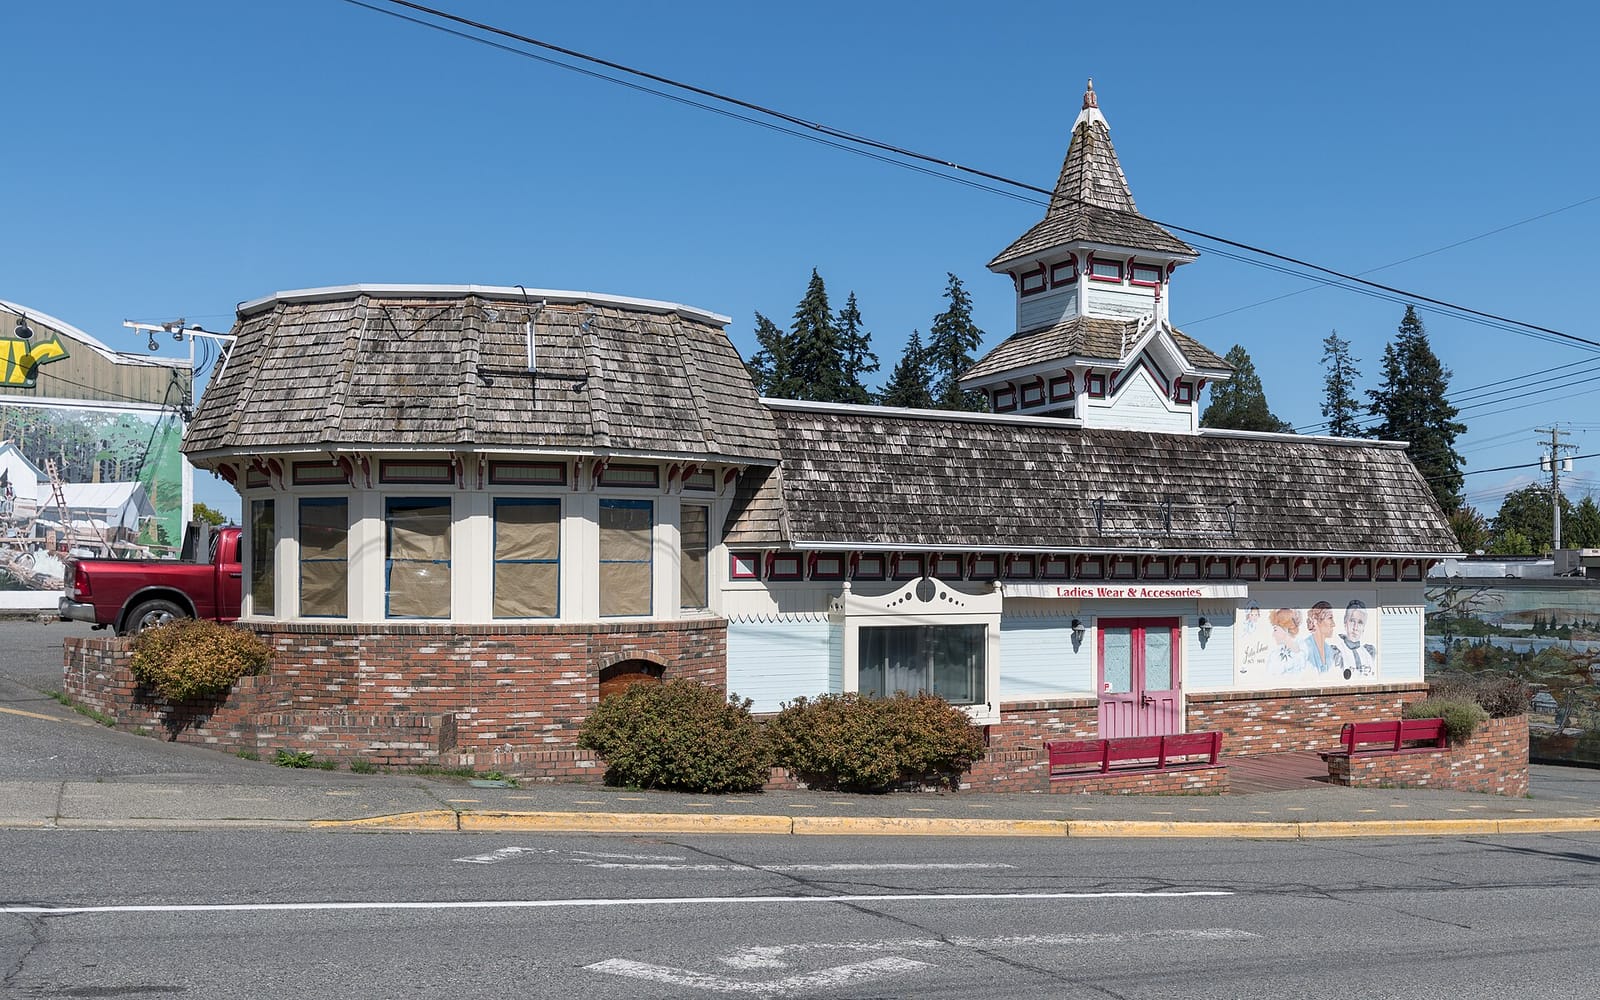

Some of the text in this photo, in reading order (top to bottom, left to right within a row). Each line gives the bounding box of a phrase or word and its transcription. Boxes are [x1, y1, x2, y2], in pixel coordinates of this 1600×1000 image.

[1056, 587, 1202, 598] Ladies Wear & Accessories
